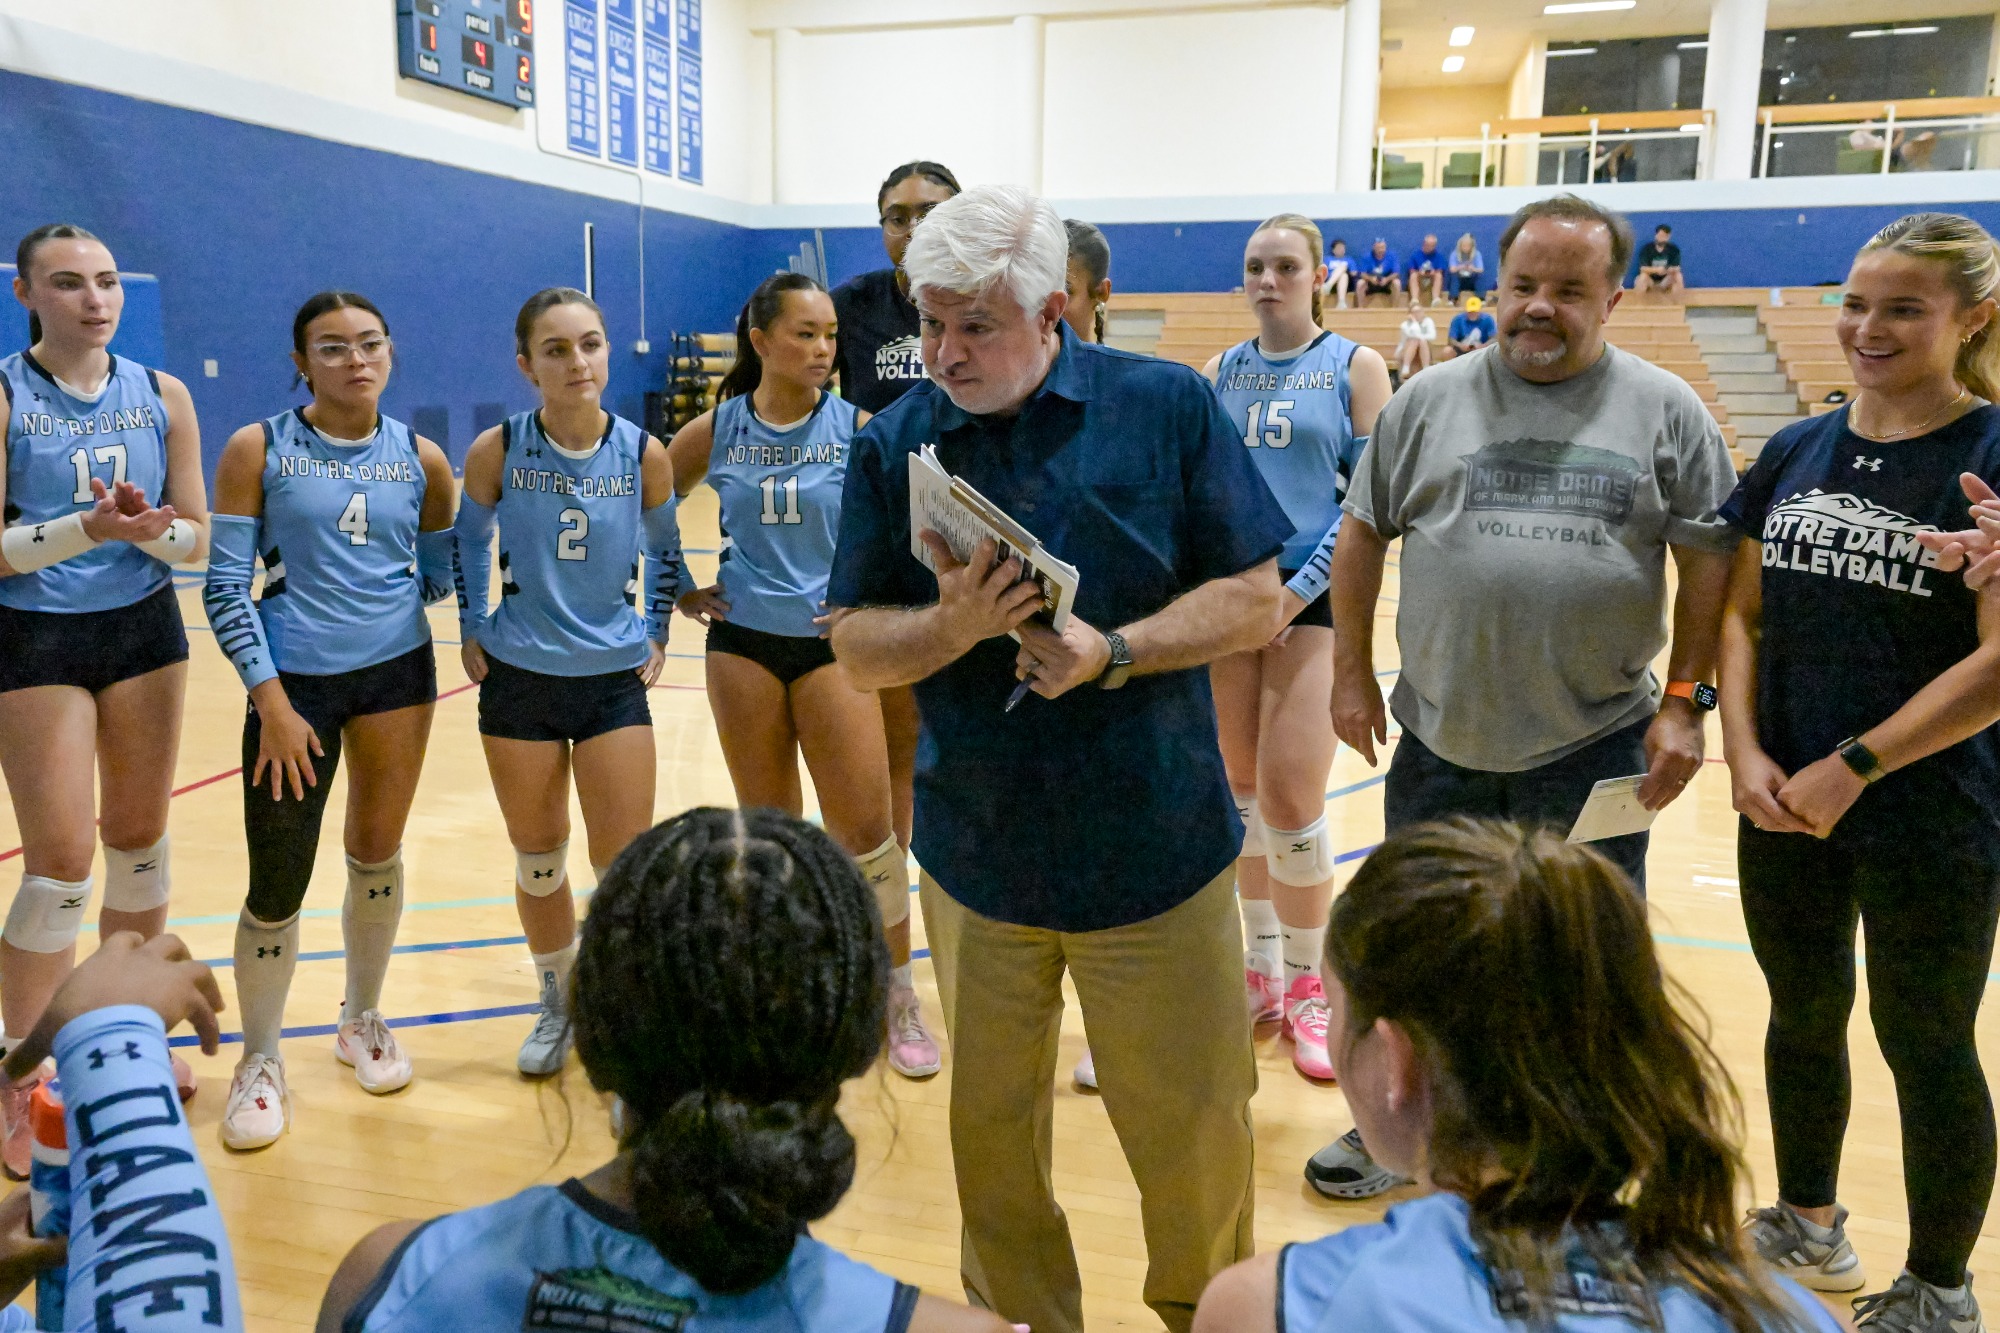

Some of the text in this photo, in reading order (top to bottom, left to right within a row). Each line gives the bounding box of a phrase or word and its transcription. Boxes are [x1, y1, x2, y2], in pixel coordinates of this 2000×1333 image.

[474, 41, 487, 67] 4
[518, 56, 531, 83] 2
[875, 350, 923, 364] NOTR
[875, 365, 930, 380] VOLLE
[1224, 371, 1335, 392] NOTRE DAME
[21, 412, 96, 438] NOTRE
[1243, 400, 1295, 449] 15
[725, 443, 843, 466] NOTRE DAME
[69, 443, 128, 504] 17
[280, 456, 413, 482] NOTRE DAME
[511, 467, 635, 498] NOTRE DAME
[1474, 492, 1487, 502] OF
[1475, 467, 1629, 500] NOTRE DAME
[759, 475, 802, 525] 11
[337, 492, 370, 546] 4
[556, 507, 589, 561] 2
[75, 1085, 223, 1333] DAME
